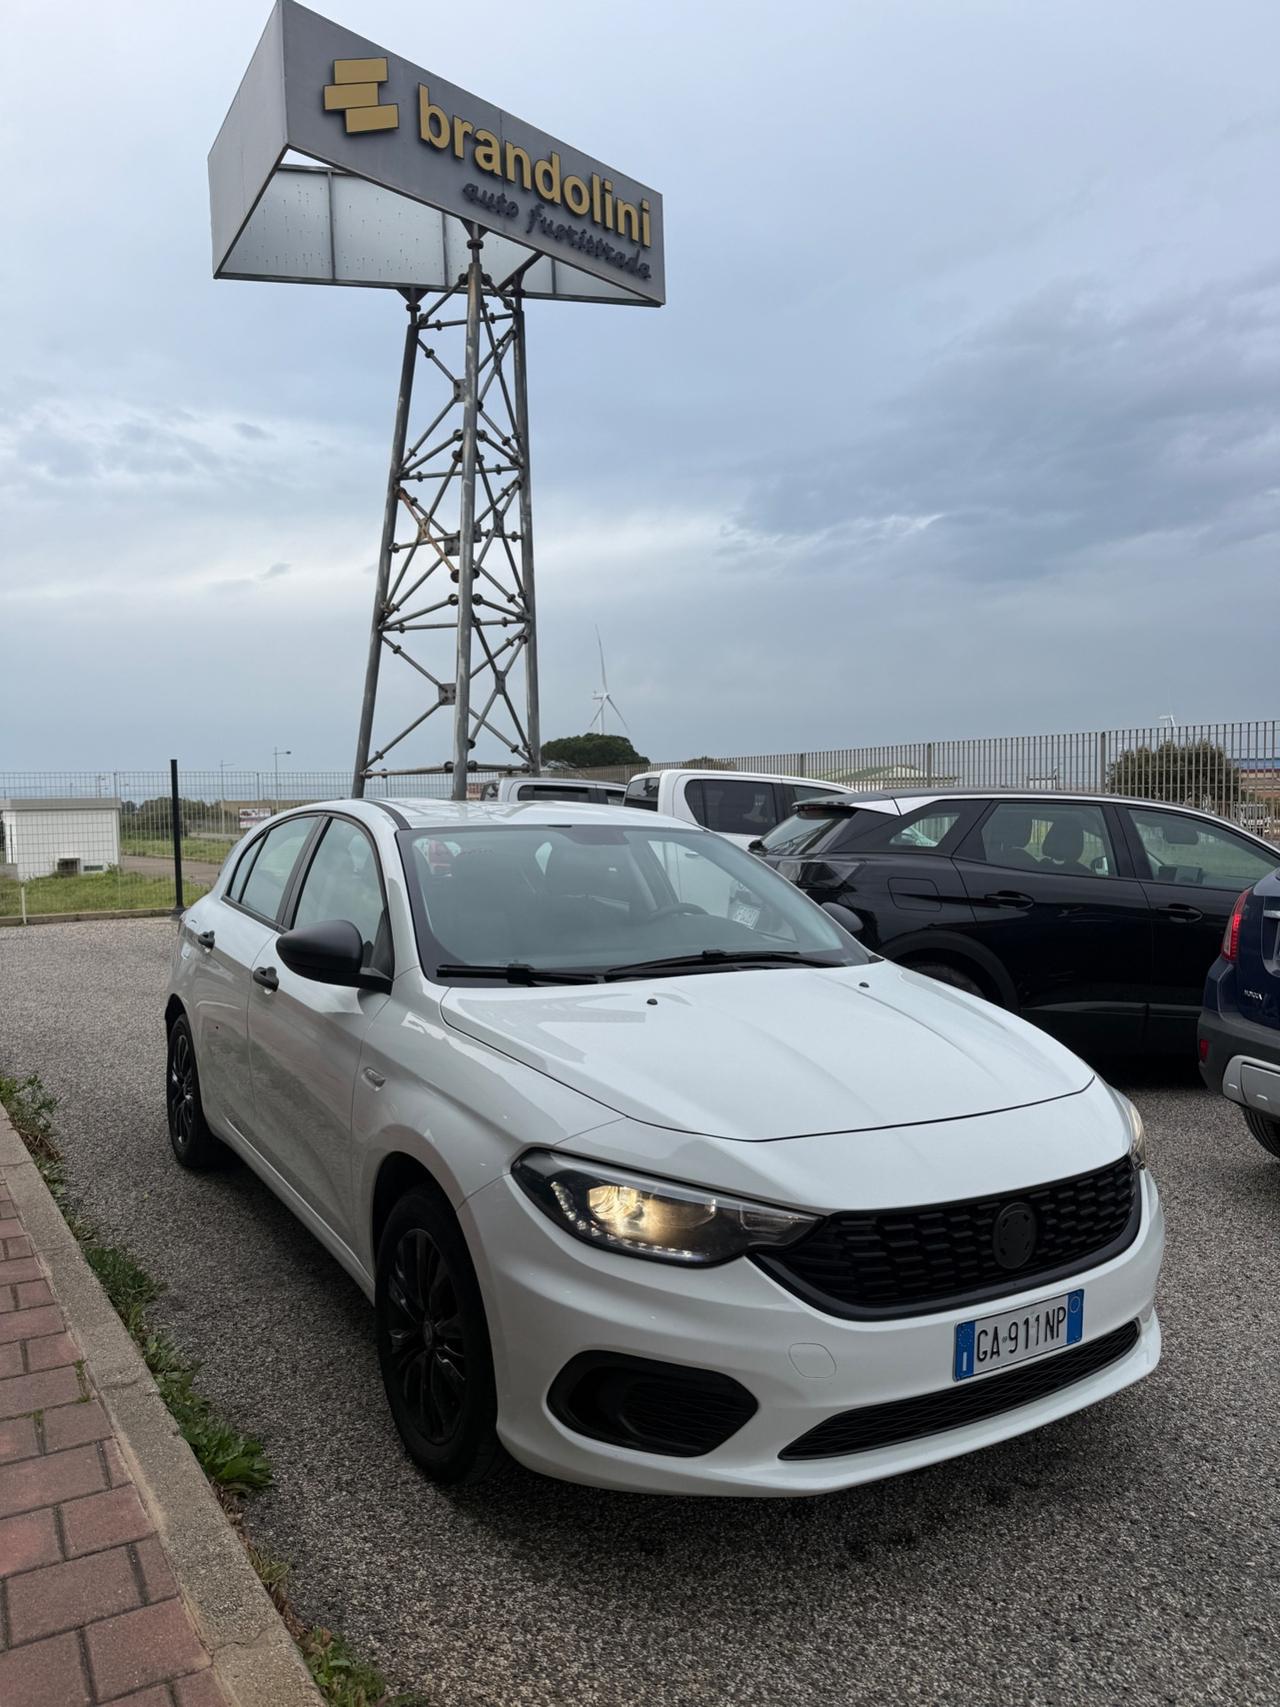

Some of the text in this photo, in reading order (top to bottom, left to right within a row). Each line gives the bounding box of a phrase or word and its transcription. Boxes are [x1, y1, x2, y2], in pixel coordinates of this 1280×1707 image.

[418, 83, 651, 248] brandolini
[462, 183, 651, 280] auto fuoristrada
